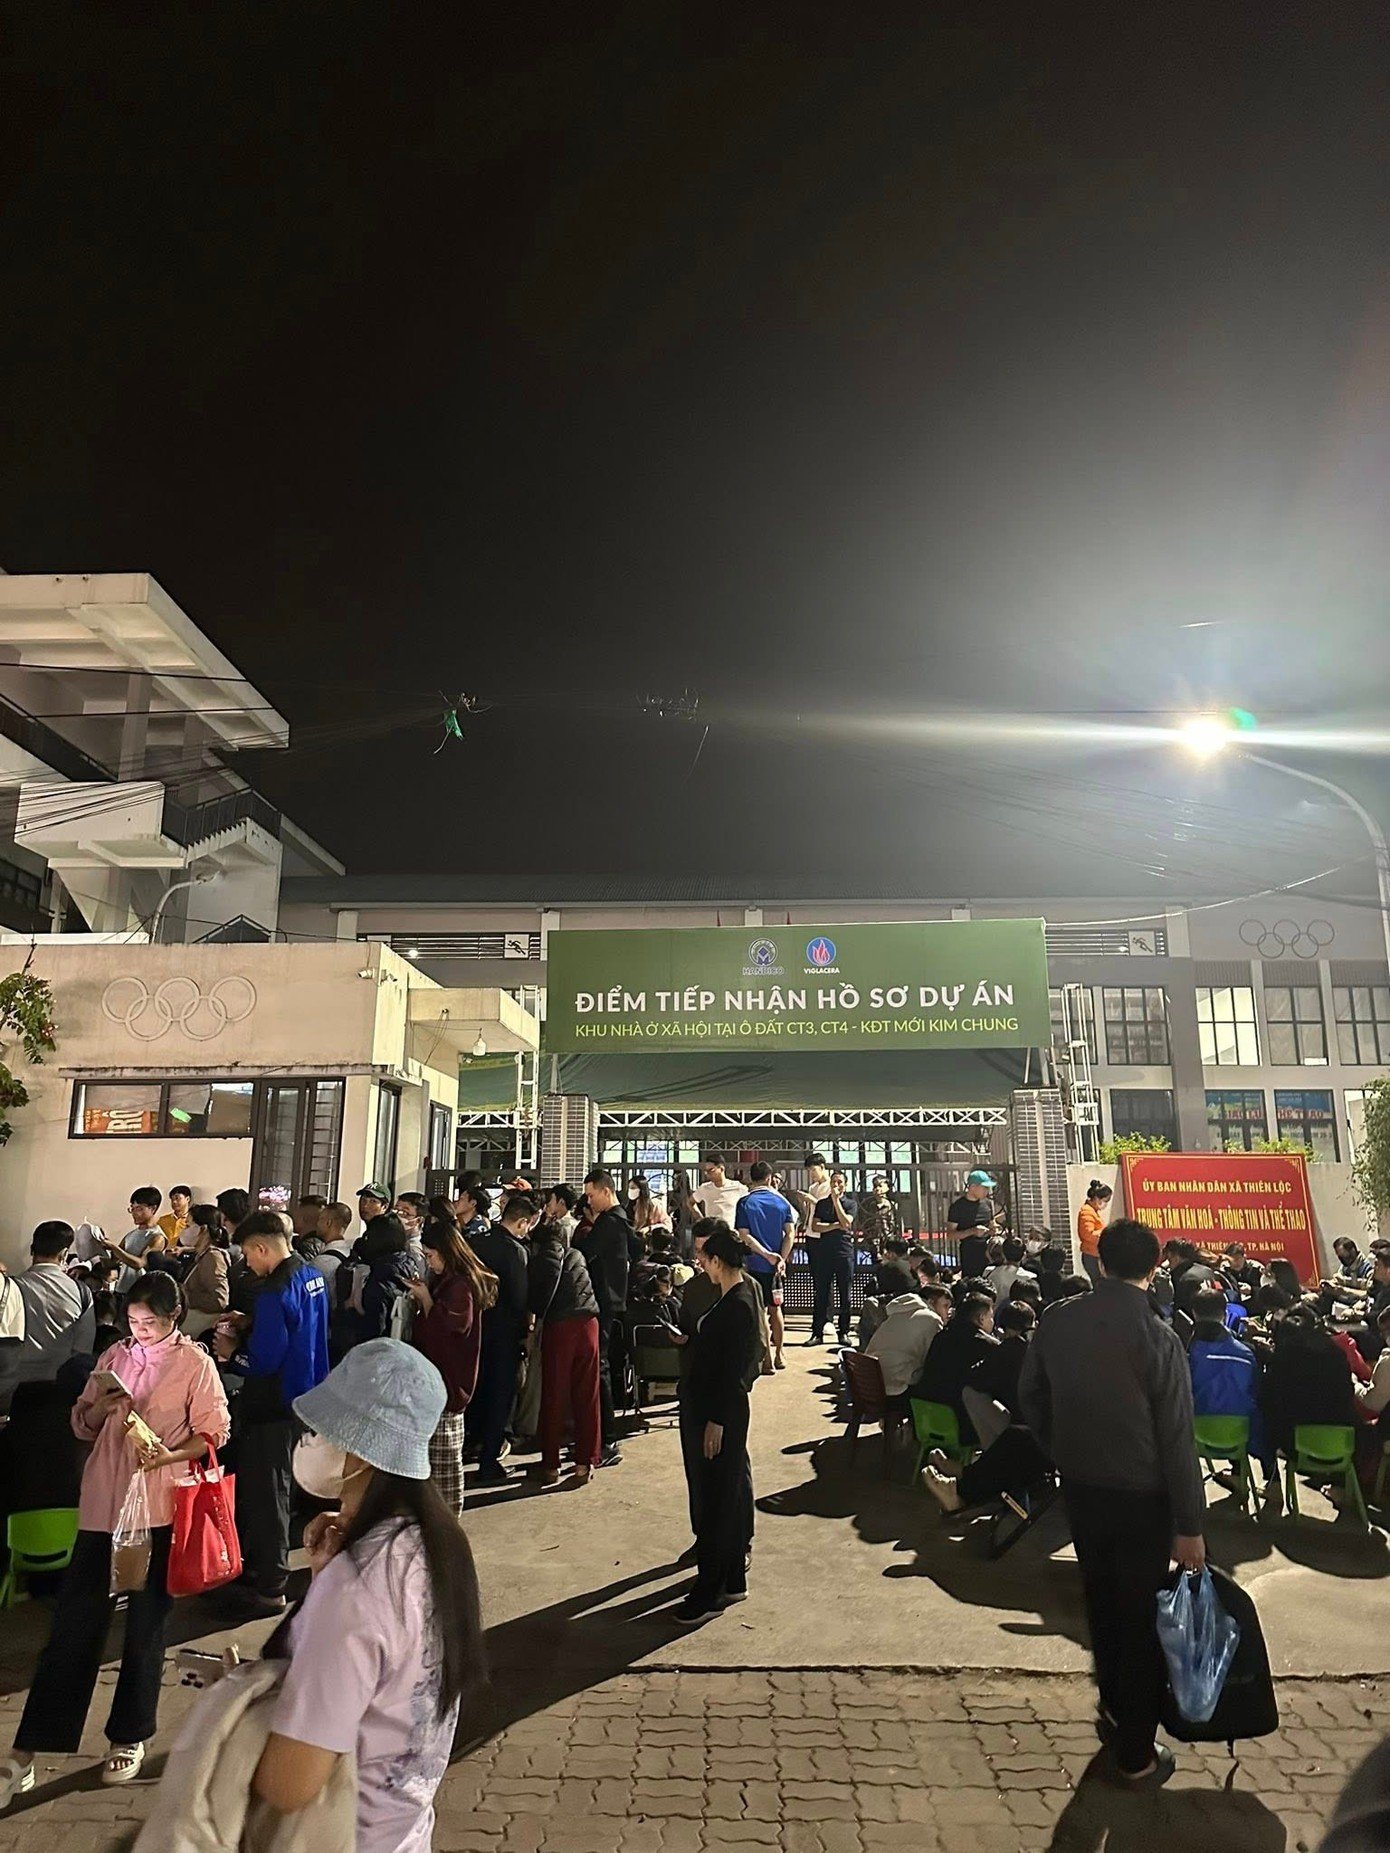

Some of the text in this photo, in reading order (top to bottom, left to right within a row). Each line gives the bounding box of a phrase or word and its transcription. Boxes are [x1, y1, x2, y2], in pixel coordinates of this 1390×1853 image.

[575, 980, 1014, 1015] ĐIỂM TIẾP NHẬN HỒ SƠ DỰ ÁN
[575, 1024, 607, 1037] KHU
[611, 1021, 643, 1036] NHÀ
[646, 1021, 659, 1036] Ở
[661, 1021, 682, 1036] XÃ
[684, 1020, 711, 1038] HỘI
[714, 1022, 736, 1038] TẠI
[739, 1019, 752, 1035] Ô
[755, 1018, 784, 1035] ĐẤT
[787, 1021, 818, 1035] CT3,
[820, 1021, 848, 1034] CT4
[861, 1020, 891, 1033] KĐT
[894, 1016, 925, 1033] MỚI
[929, 1019, 958, 1032] KIM
[961, 1017, 1018, 1031] CHUNG
[1157, 1181, 1177, 1192] BAN
[1179, 1180, 1206, 1192] NHÂN
[1207, 1180, 1227, 1192] DÂN
[1229, 1180, 1242, 1193] XÃ
[1243, 1180, 1272, 1193] THIÊN
[1273, 1180, 1292, 1195] LỘC
[1136, 1207, 1163, 1229] TRUNG
[1163, 1203, 1180, 1229] TÂM
[1180, 1203, 1198, 1230] VĂN
[1197, 1203, 1214, 1230] HOÁ
[1218, 1204, 1245, 1230] THÔNG
[1244, 1208, 1259, 1230] TIN
[1258, 1204, 1270, 1230] VÀ
[1269, 1201, 1285, 1230] THỂ
[1284, 1208, 1306, 1230] THAO
[1247, 1242, 1258, 1251] TP.
[1259, 1241, 1269, 1251] HÀ
[1271, 1242, 1284, 1253] NỘI
